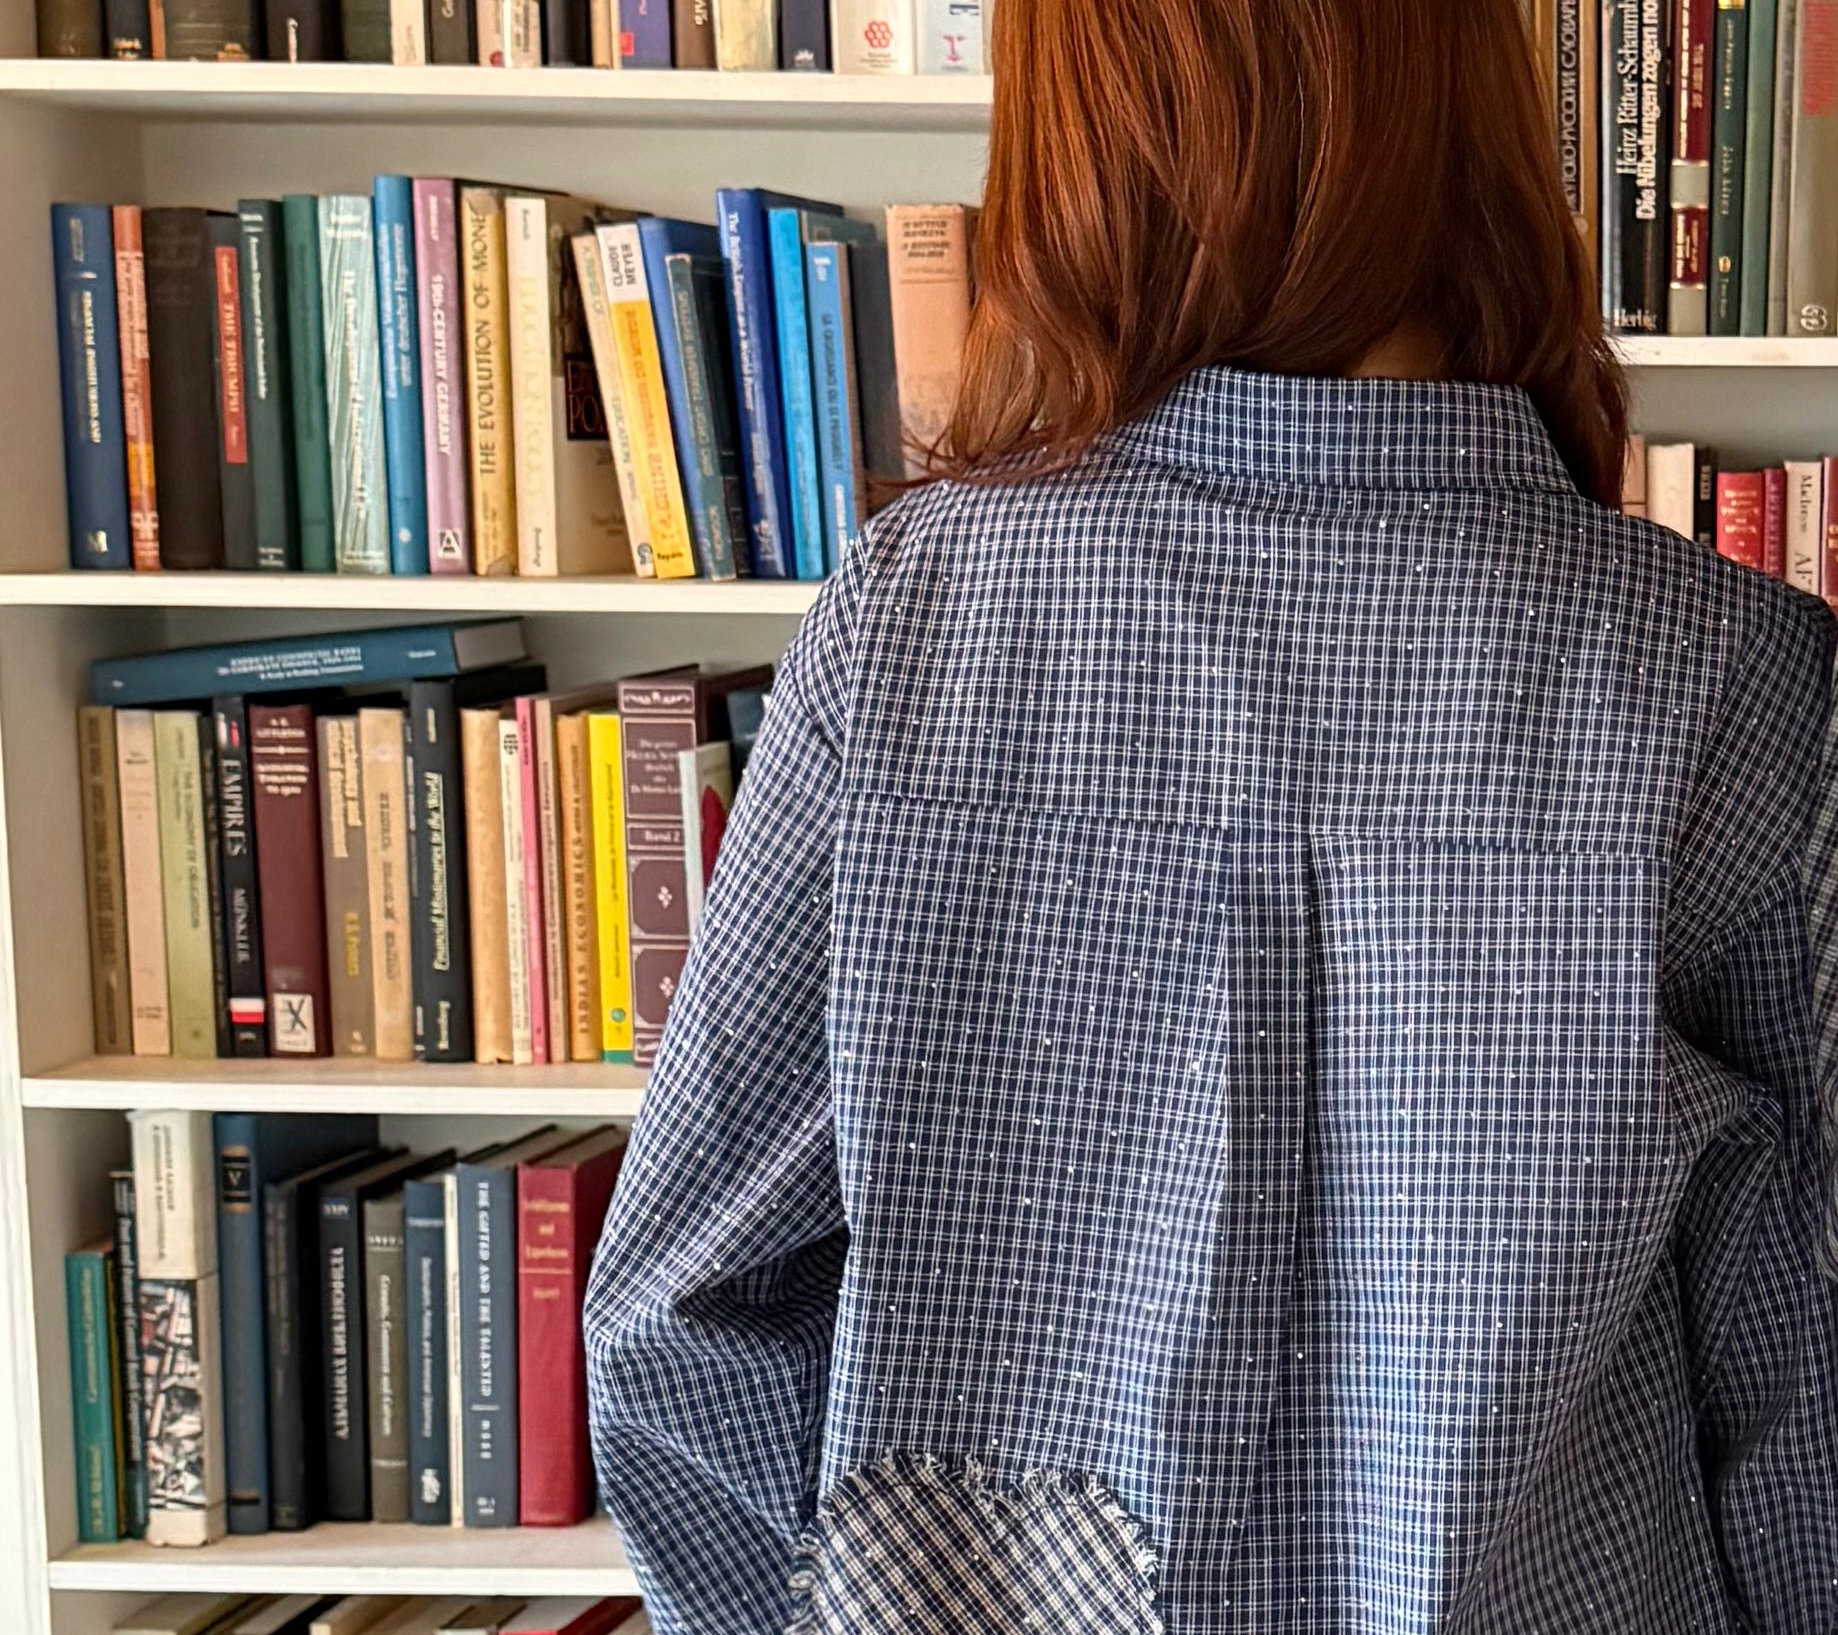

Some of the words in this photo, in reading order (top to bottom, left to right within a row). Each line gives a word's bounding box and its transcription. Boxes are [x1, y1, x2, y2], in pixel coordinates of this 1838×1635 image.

[1641, 27, 1661, 84] zogen
[1616, 128, 1638, 174] Heinz
[1636, 87, 1661, 187] Nibelungen
[1636, 189, 1656, 220] Die
[607, 245, 623, 287] CLAUDE
[619, 243, 637, 285] MEYER
[224, 302, 238, 335] THE
[471, 283, 490, 311] OF
[431, 274, 449, 380] 19th-CENTURY
[225, 341, 239, 412] TRIUMPH
[471, 320, 494, 431] EVOLUTION
[435, 382, 451, 455] GERMANY
[478, 443, 496, 477] THE
[478, 1182, 490, 1208] THE
[479, 1210, 490, 1261] GIFTED
[479, 1265, 490, 1293] AND
[480, 1297, 491, 1322] THE
[480, 1326, 491, 1396] TALENTED
